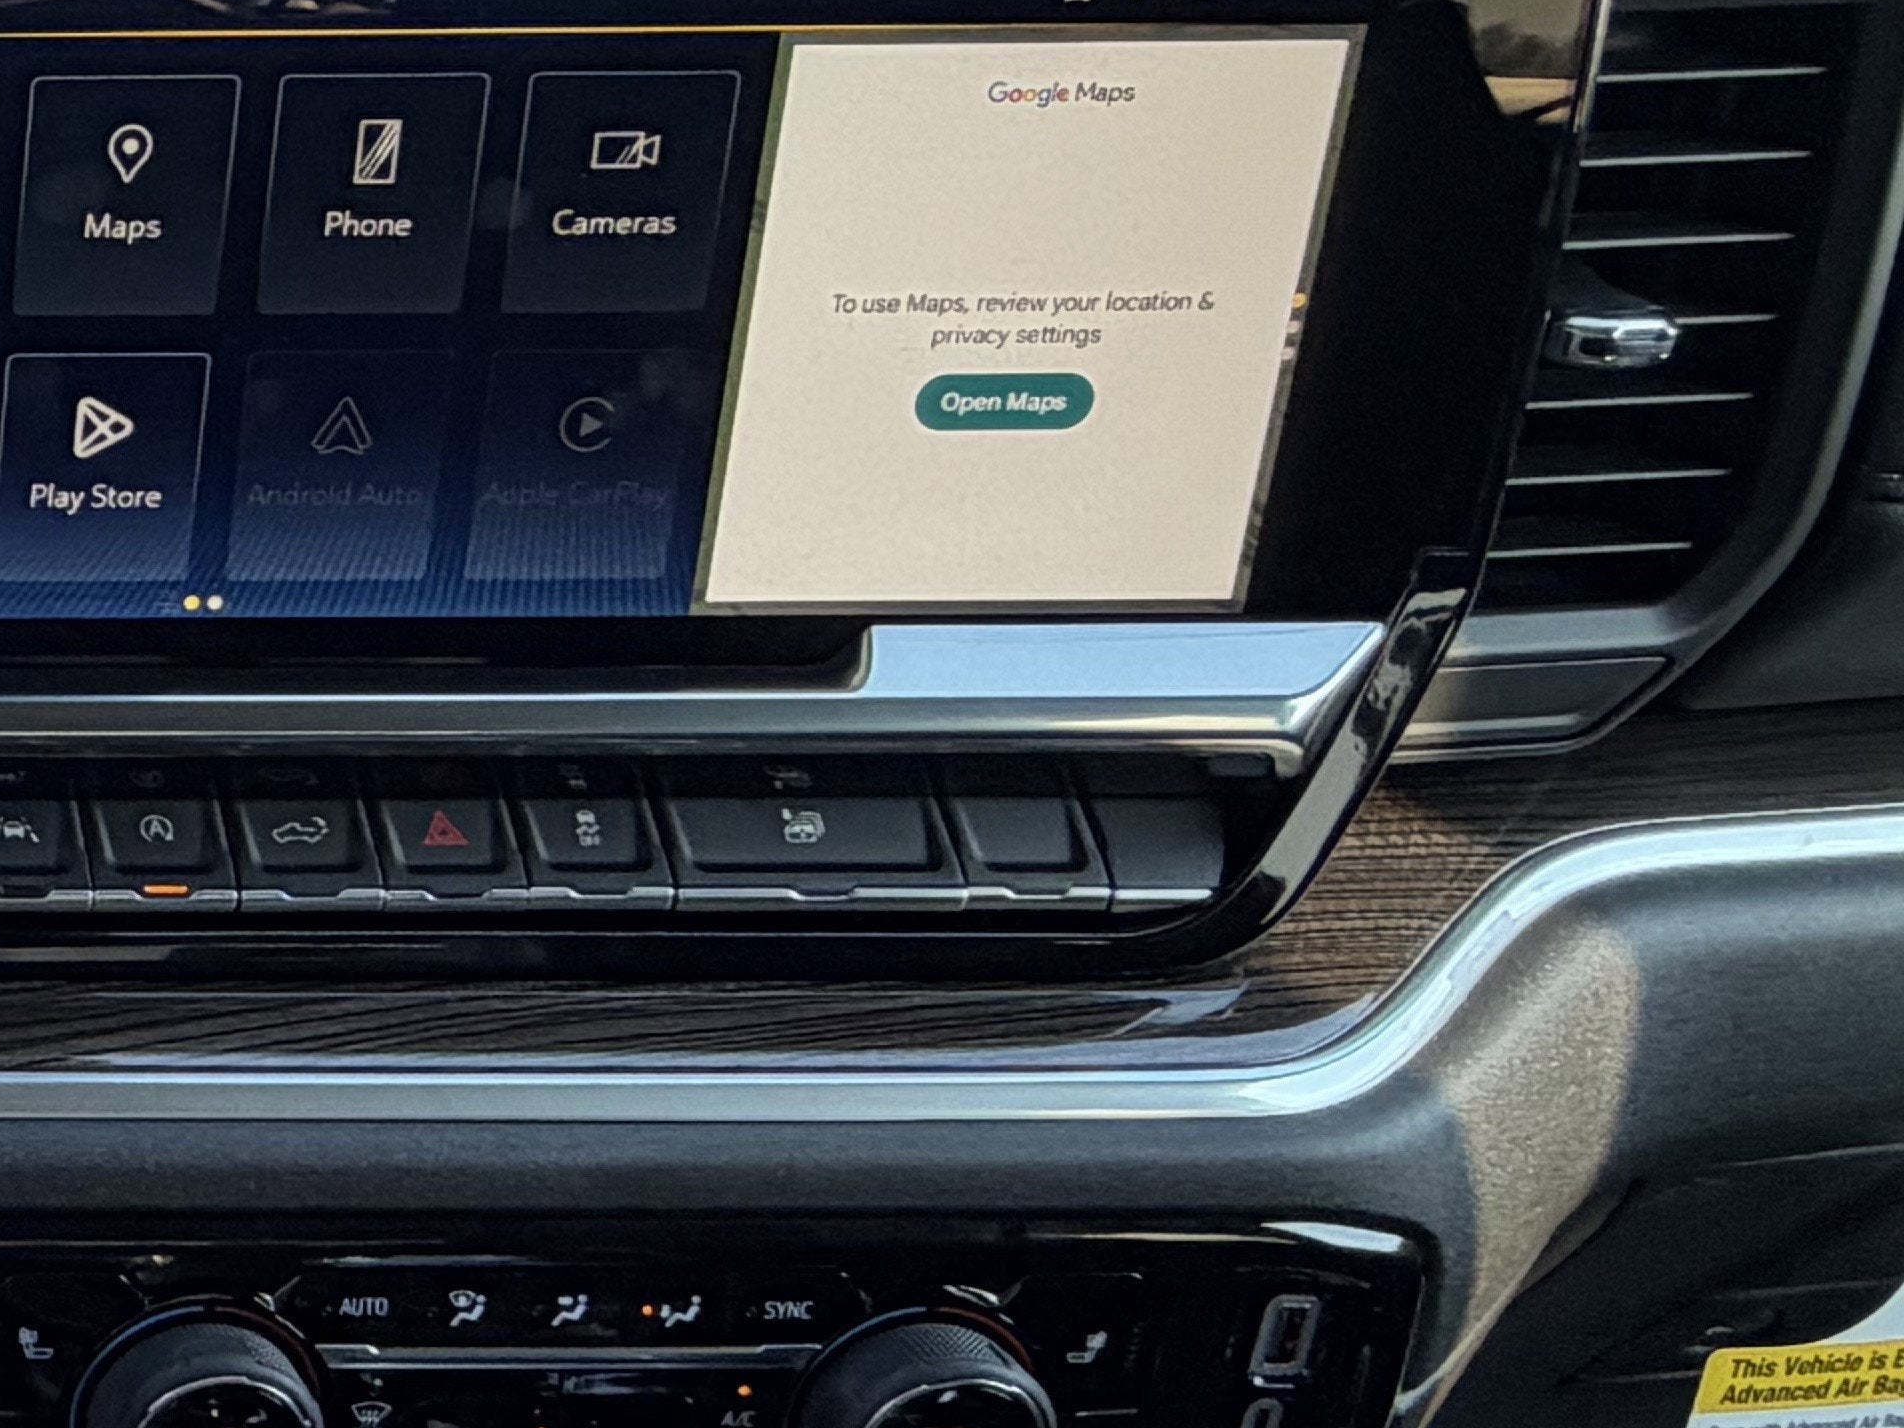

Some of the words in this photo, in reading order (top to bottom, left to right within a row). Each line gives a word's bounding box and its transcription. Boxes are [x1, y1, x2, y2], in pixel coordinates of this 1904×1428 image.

[987, 80, 1071, 108] Google
[1074, 82, 1137, 108] Maps
[83, 212, 163, 245] Maps
[323, 210, 413, 239] Phone
[552, 208, 677, 237] Cameras
[832, 293, 858, 314] To
[861, 297, 902, 315] use
[905, 293, 970, 317] Maps,
[976, 291, 1048, 313] review
[1050, 294, 1100, 317] your
[1104, 289, 1193, 312] location
[1197, 291, 1216, 311] &
[930, 323, 1011, 350] privacy
[1015, 325, 1103, 349] settings
[940, 391, 1003, 417] Open
[1005, 390, 1069, 417] Maps
[29, 483, 86, 516] Play
[90, 483, 163, 510] Store
[247, 482, 353, 507] Android
[339, 1296, 390, 1317] AUTO
[763, 1300, 815, 1321] SYNC
[1731, 1357, 1778, 1379] This
[1784, 1353, 1864, 1376] Vehicle
[1869, 1350, 1888, 1370] is
[1719, 1379, 1833, 1405] Advanced
[1833, 1376, 1870, 1399] Air
[720, 1409, 758, 1428] A/C
